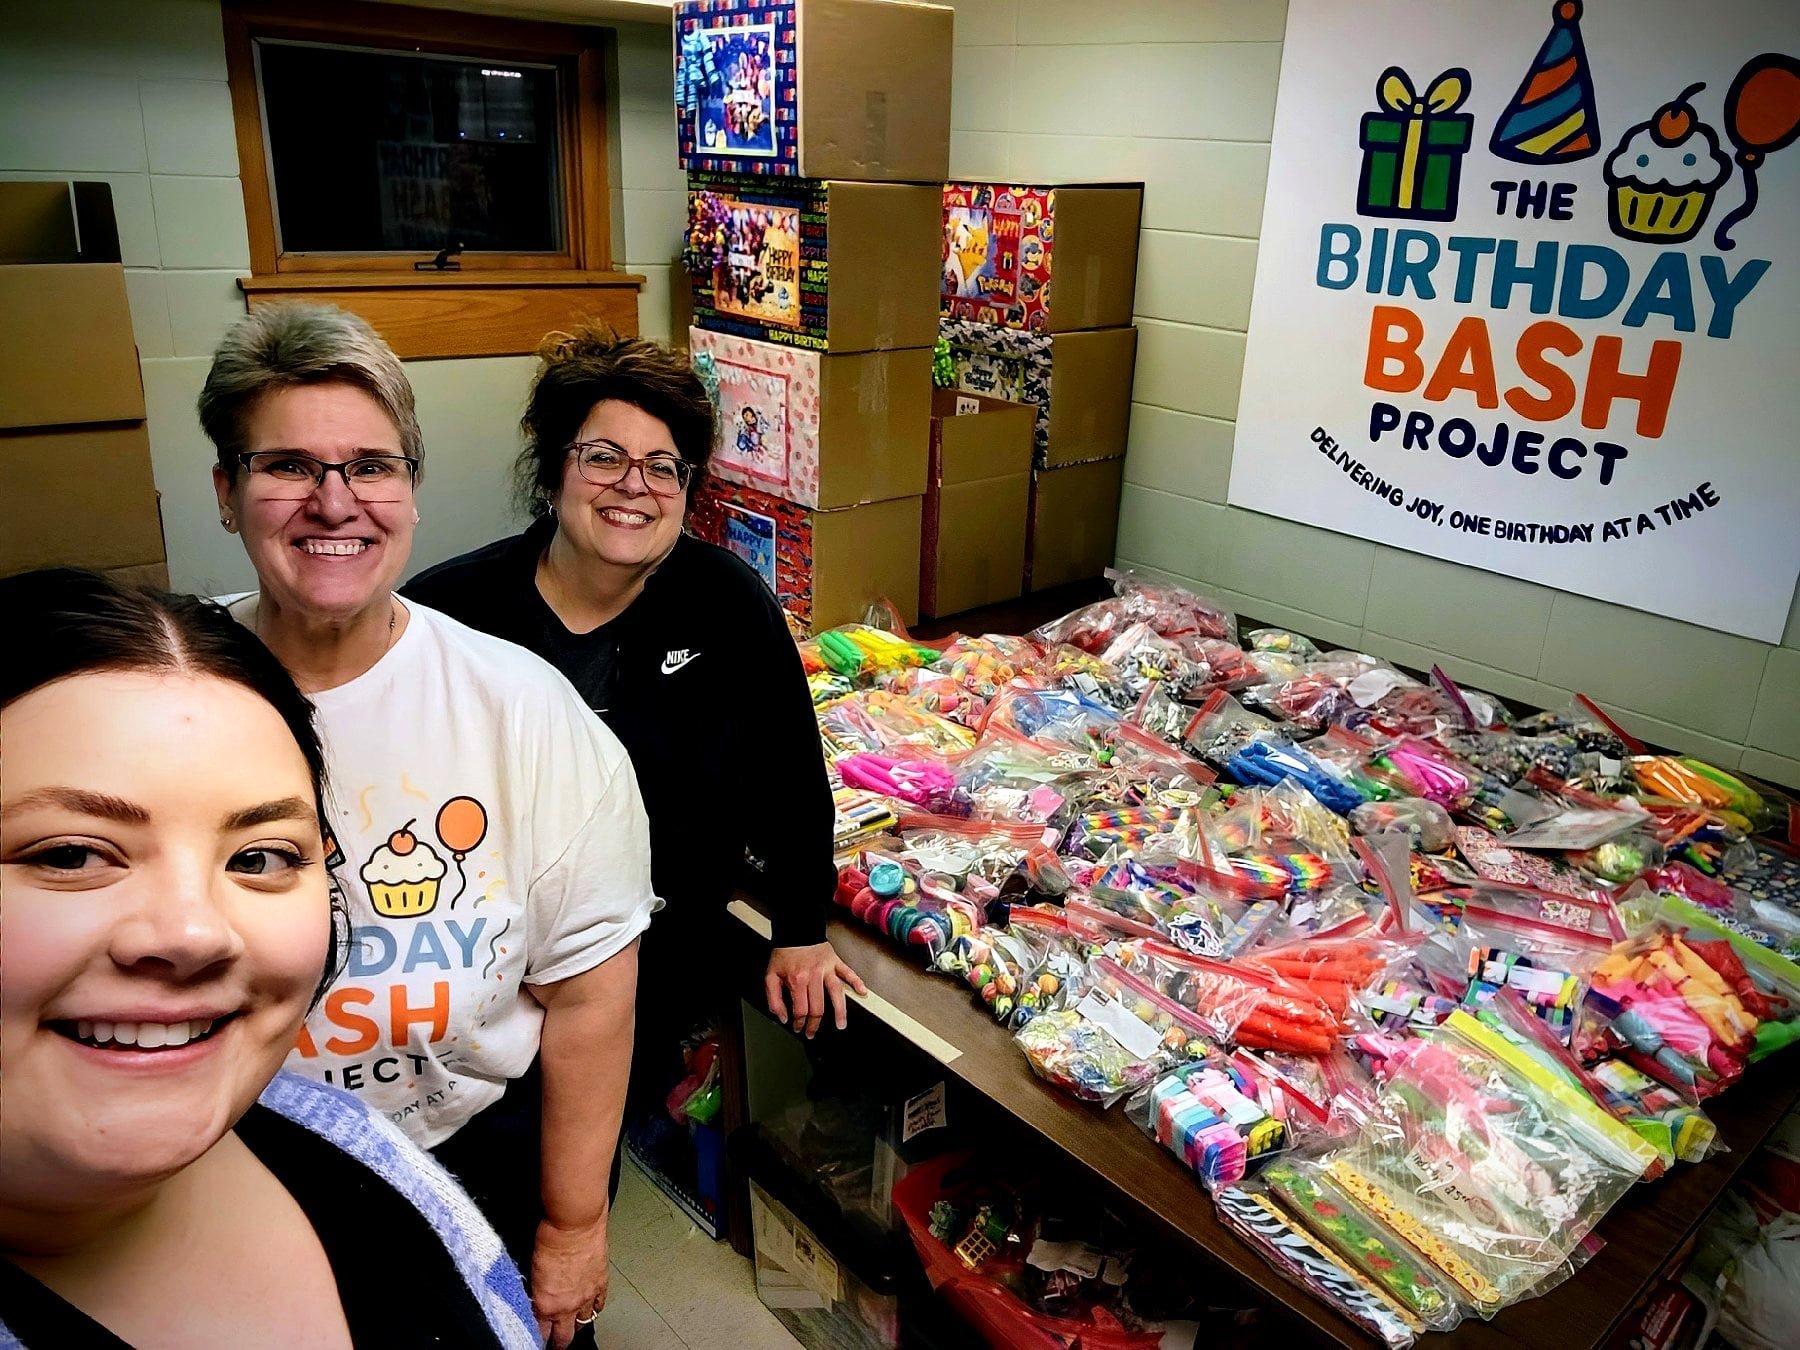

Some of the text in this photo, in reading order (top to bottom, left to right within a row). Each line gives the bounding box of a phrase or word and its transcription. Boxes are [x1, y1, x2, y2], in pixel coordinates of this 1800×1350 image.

[1490, 180, 1578, 221] THE
[1316, 222, 1772, 339] BIRTHDAY
[769, 329, 793, 344] HAPPY
[1363, 305, 1682, 439] BASH
[1369, 402, 1629, 486] PROJECT
[1310, 426, 1721, 545] DELIVERING JOY, ONE BIRTHDAY AT A TIME
[666, 649, 690, 665] NIKE
[426, 1089, 445, 1106] AT
